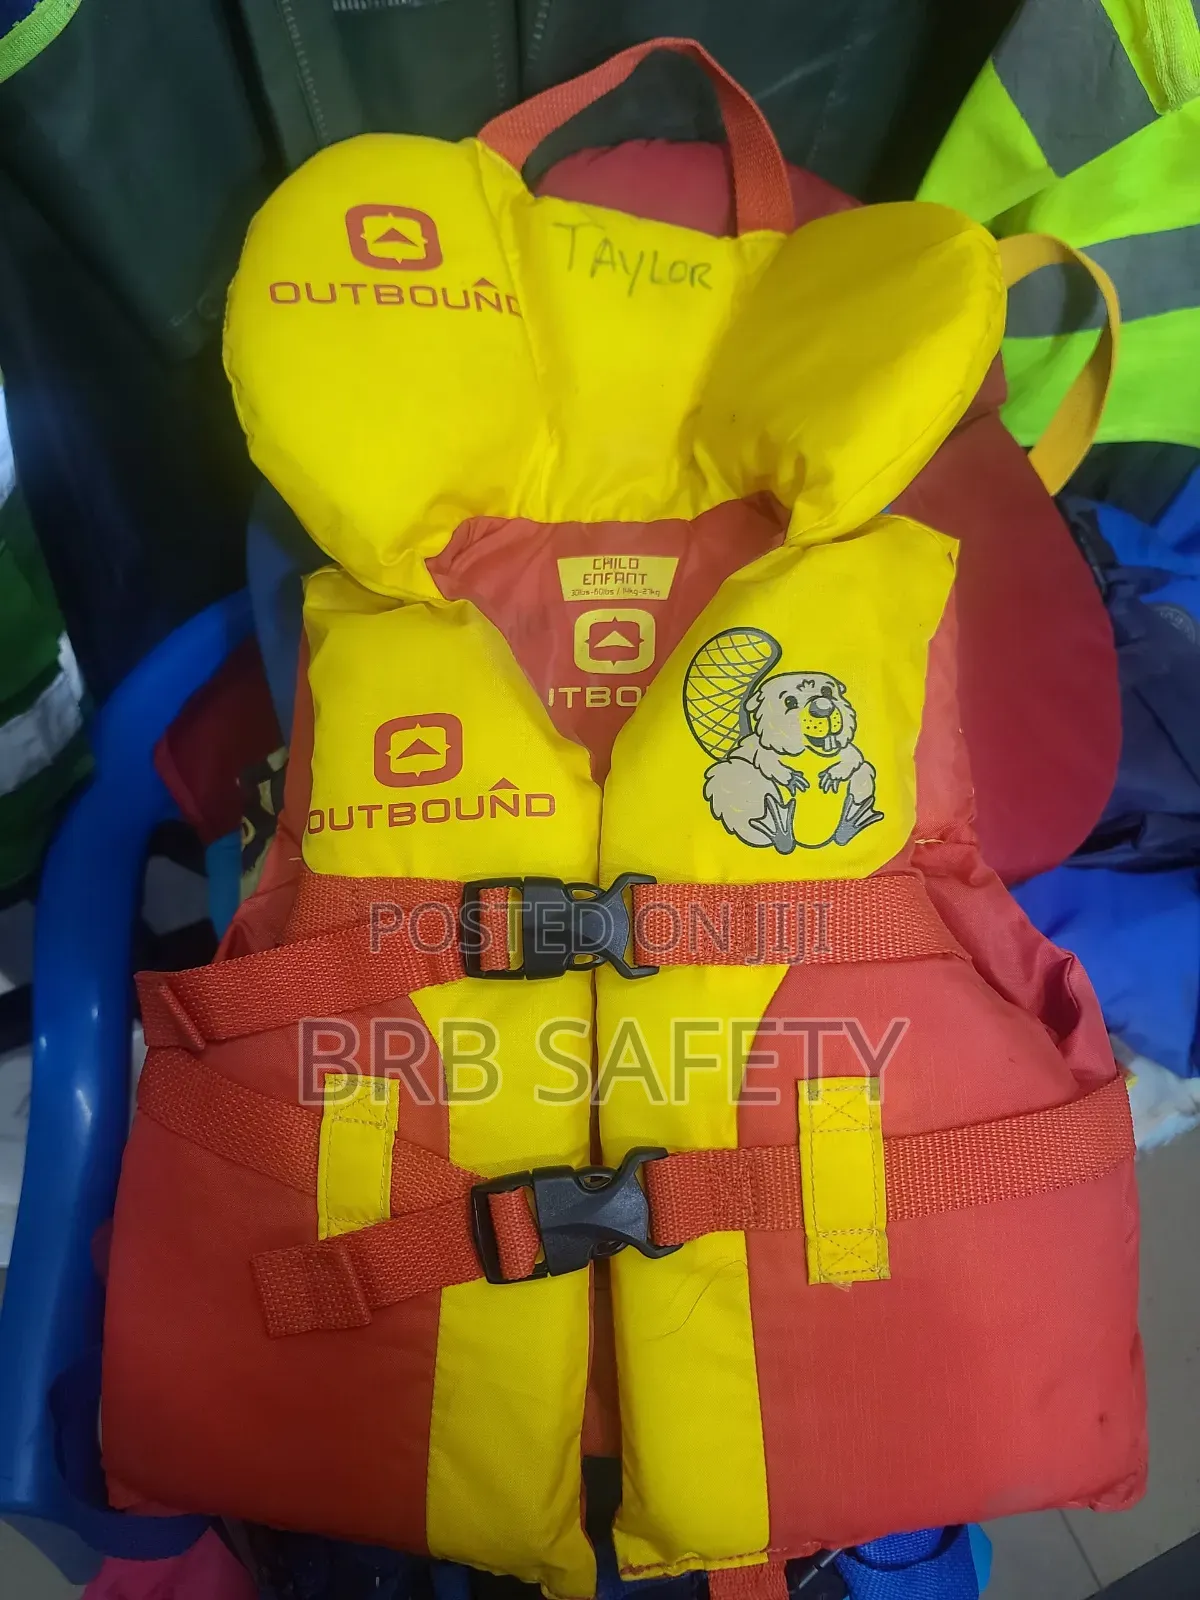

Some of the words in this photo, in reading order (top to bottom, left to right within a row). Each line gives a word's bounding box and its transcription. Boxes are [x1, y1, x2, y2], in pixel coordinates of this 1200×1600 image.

[552, 222, 713, 298] TAYLOR
[582, 572, 648, 585] ENFANT
[307, 791, 556, 835] OUTBOUND
